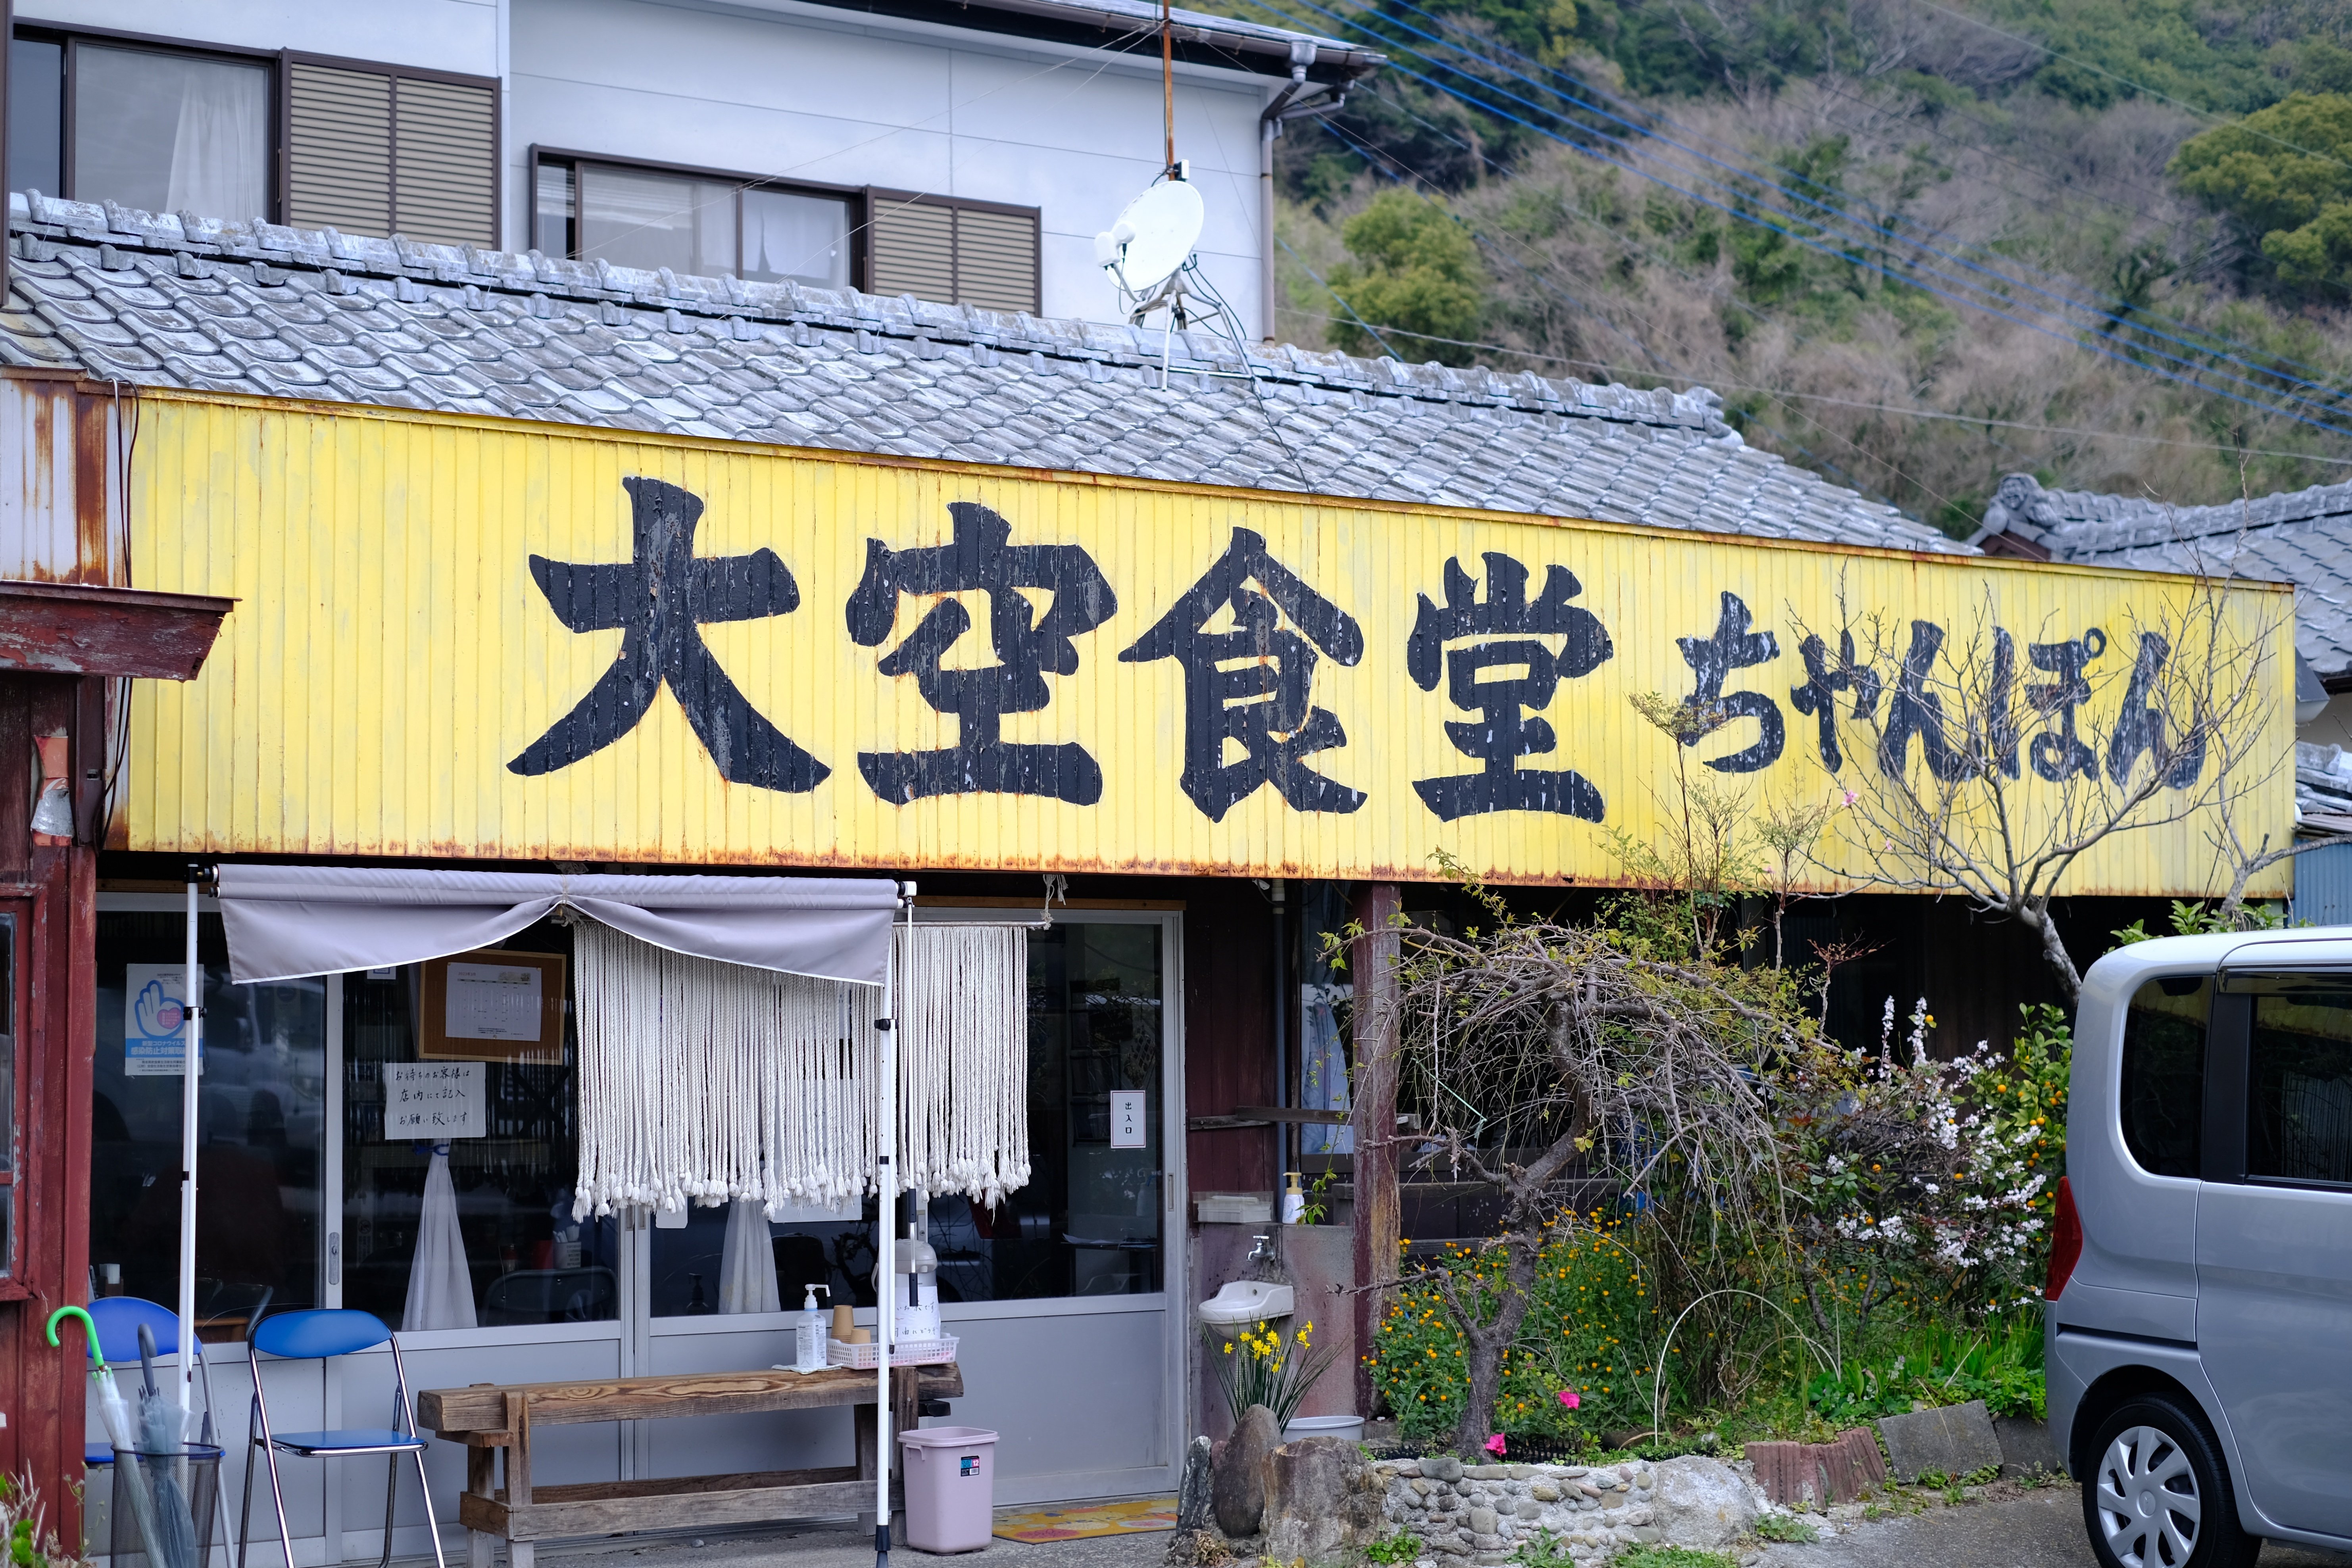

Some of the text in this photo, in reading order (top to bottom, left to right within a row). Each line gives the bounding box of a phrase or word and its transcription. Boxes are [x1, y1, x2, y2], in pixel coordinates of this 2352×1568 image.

[506, 476, 1613, 823] 大空食堂
[1675, 590, 2206, 790] ちゃんぽん
[396, 1066, 470, 1081] お待ちのお客様は
[399, 1086, 465, 1103] 店内にて記入
[399, 1111, 467, 1127] お願い致します
